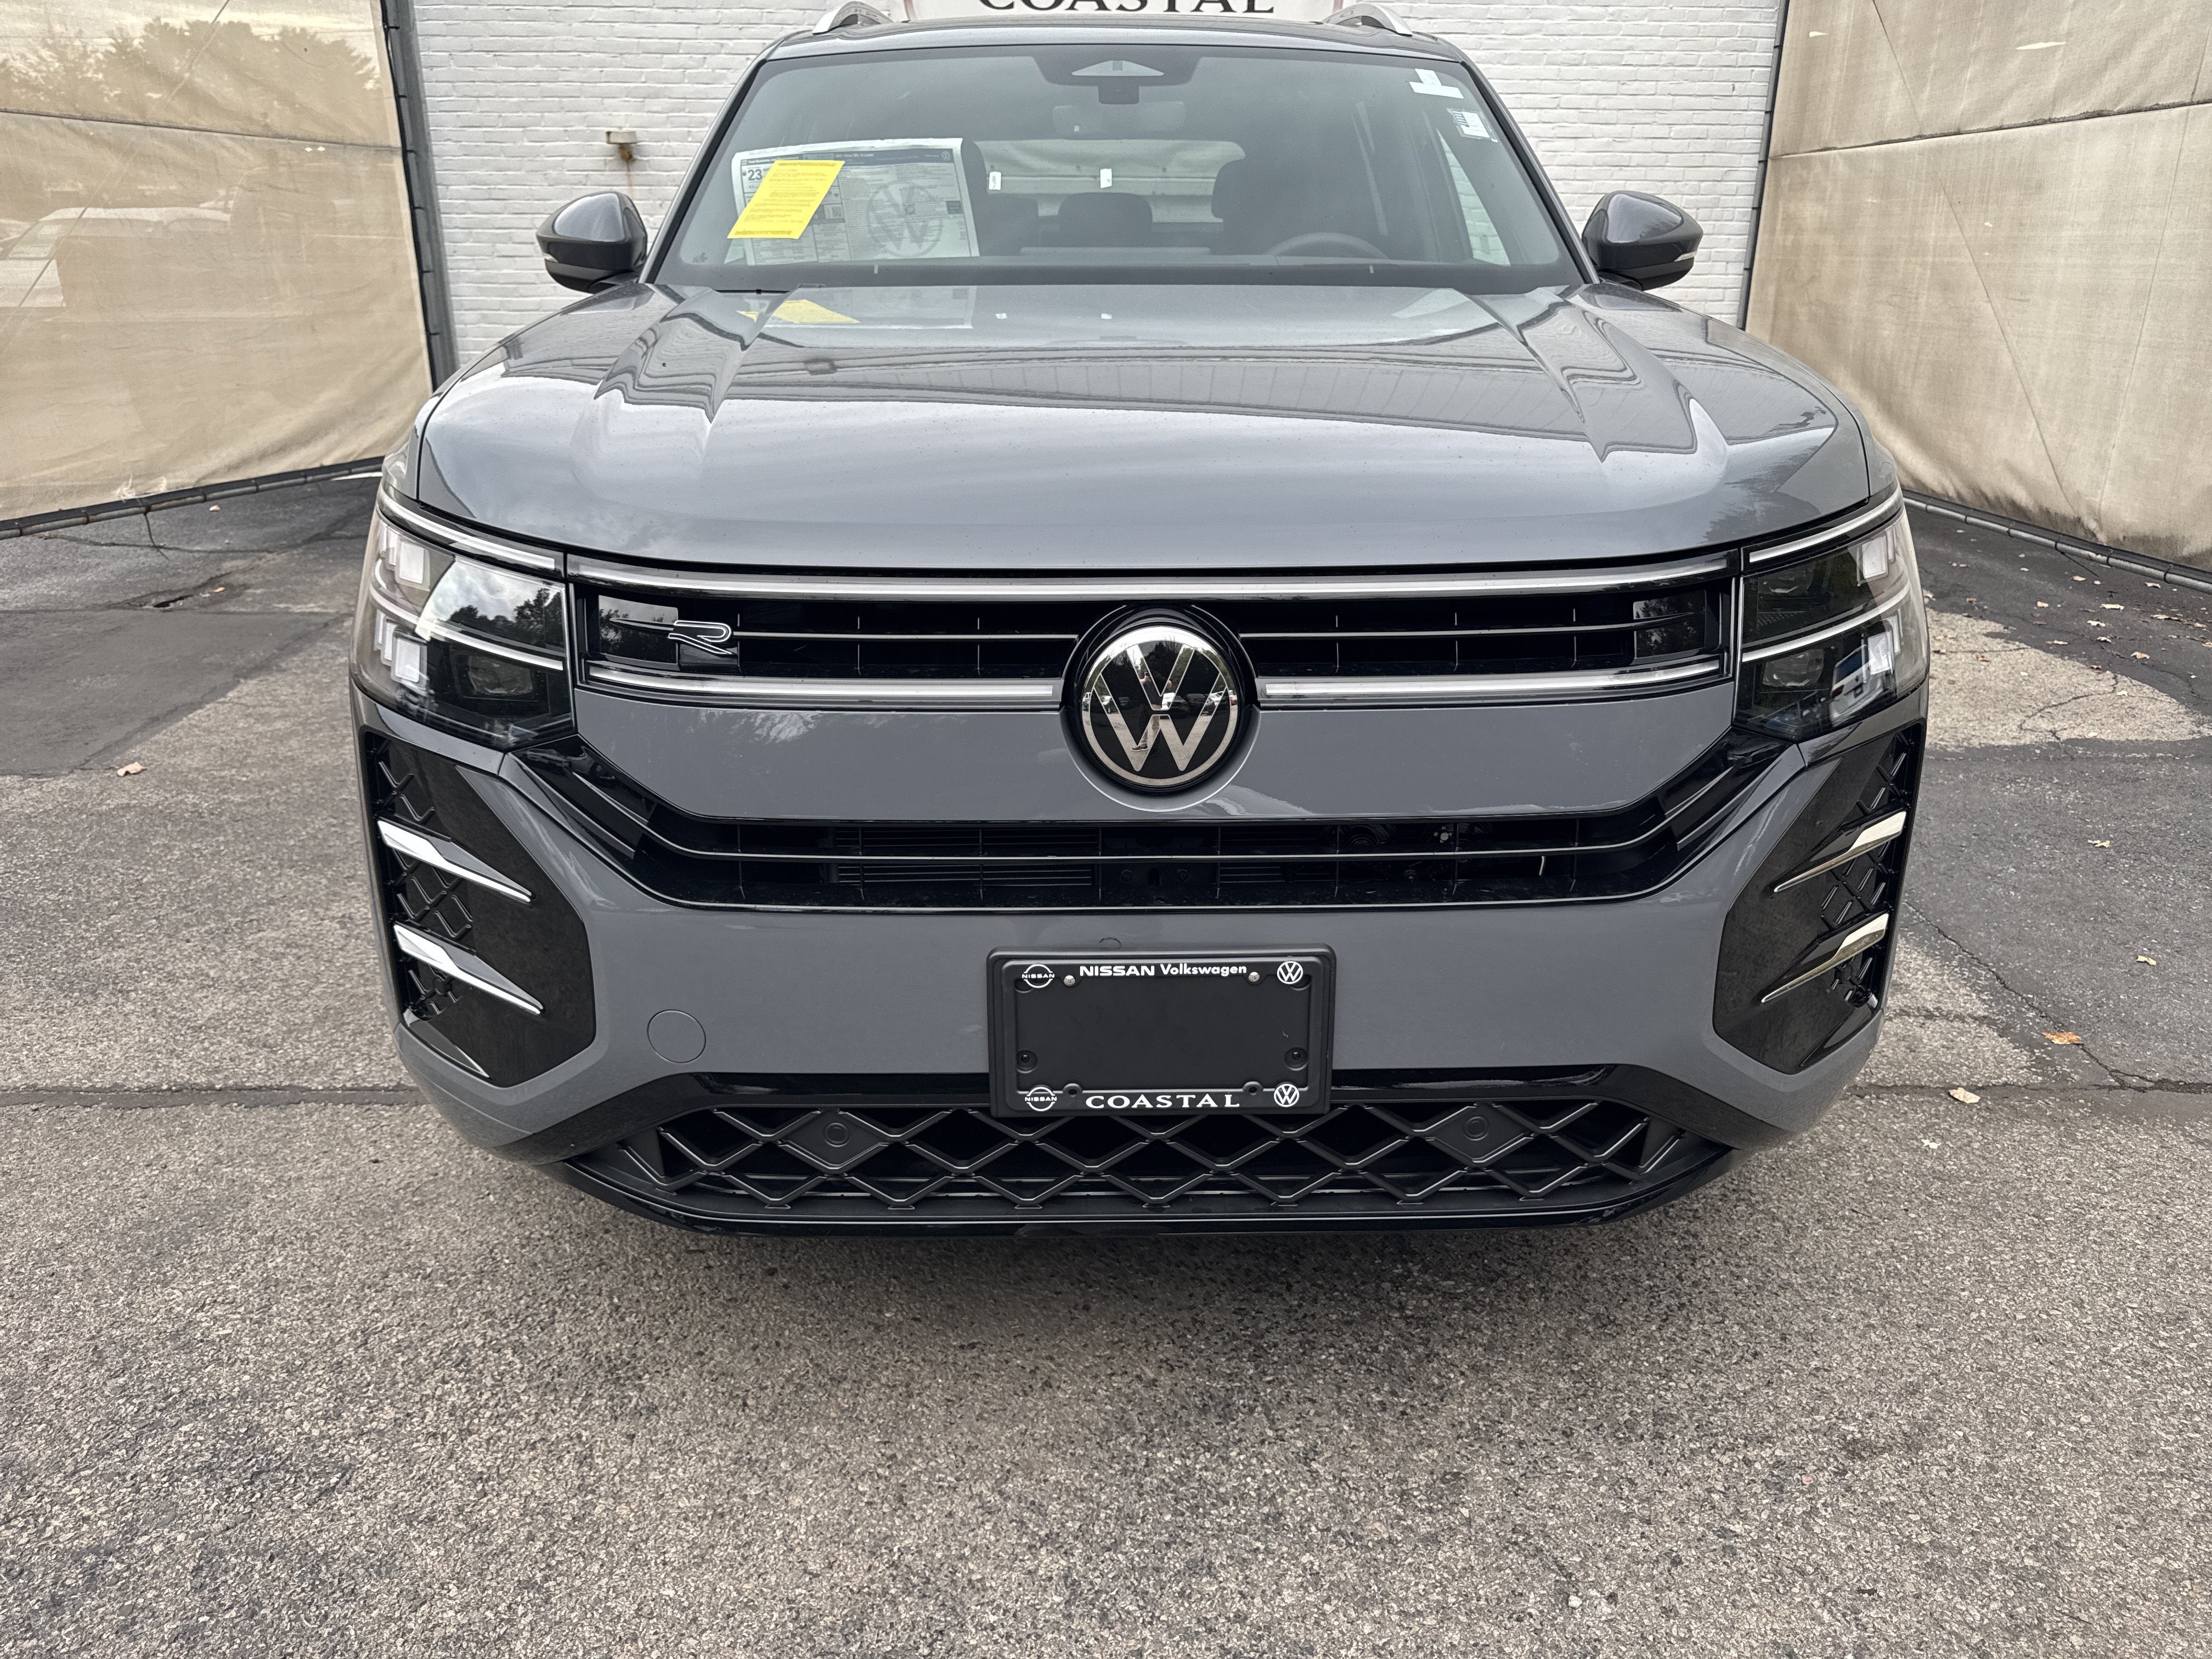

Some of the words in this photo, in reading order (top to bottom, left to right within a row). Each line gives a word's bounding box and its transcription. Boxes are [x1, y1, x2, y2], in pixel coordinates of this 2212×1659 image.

[748, 169, 763, 180] 23
[1080, 966, 1155, 977] NISSAN
[1160, 963, 1247, 977] Volkswagen
[1085, 1093, 1240, 1109] COASTAL
